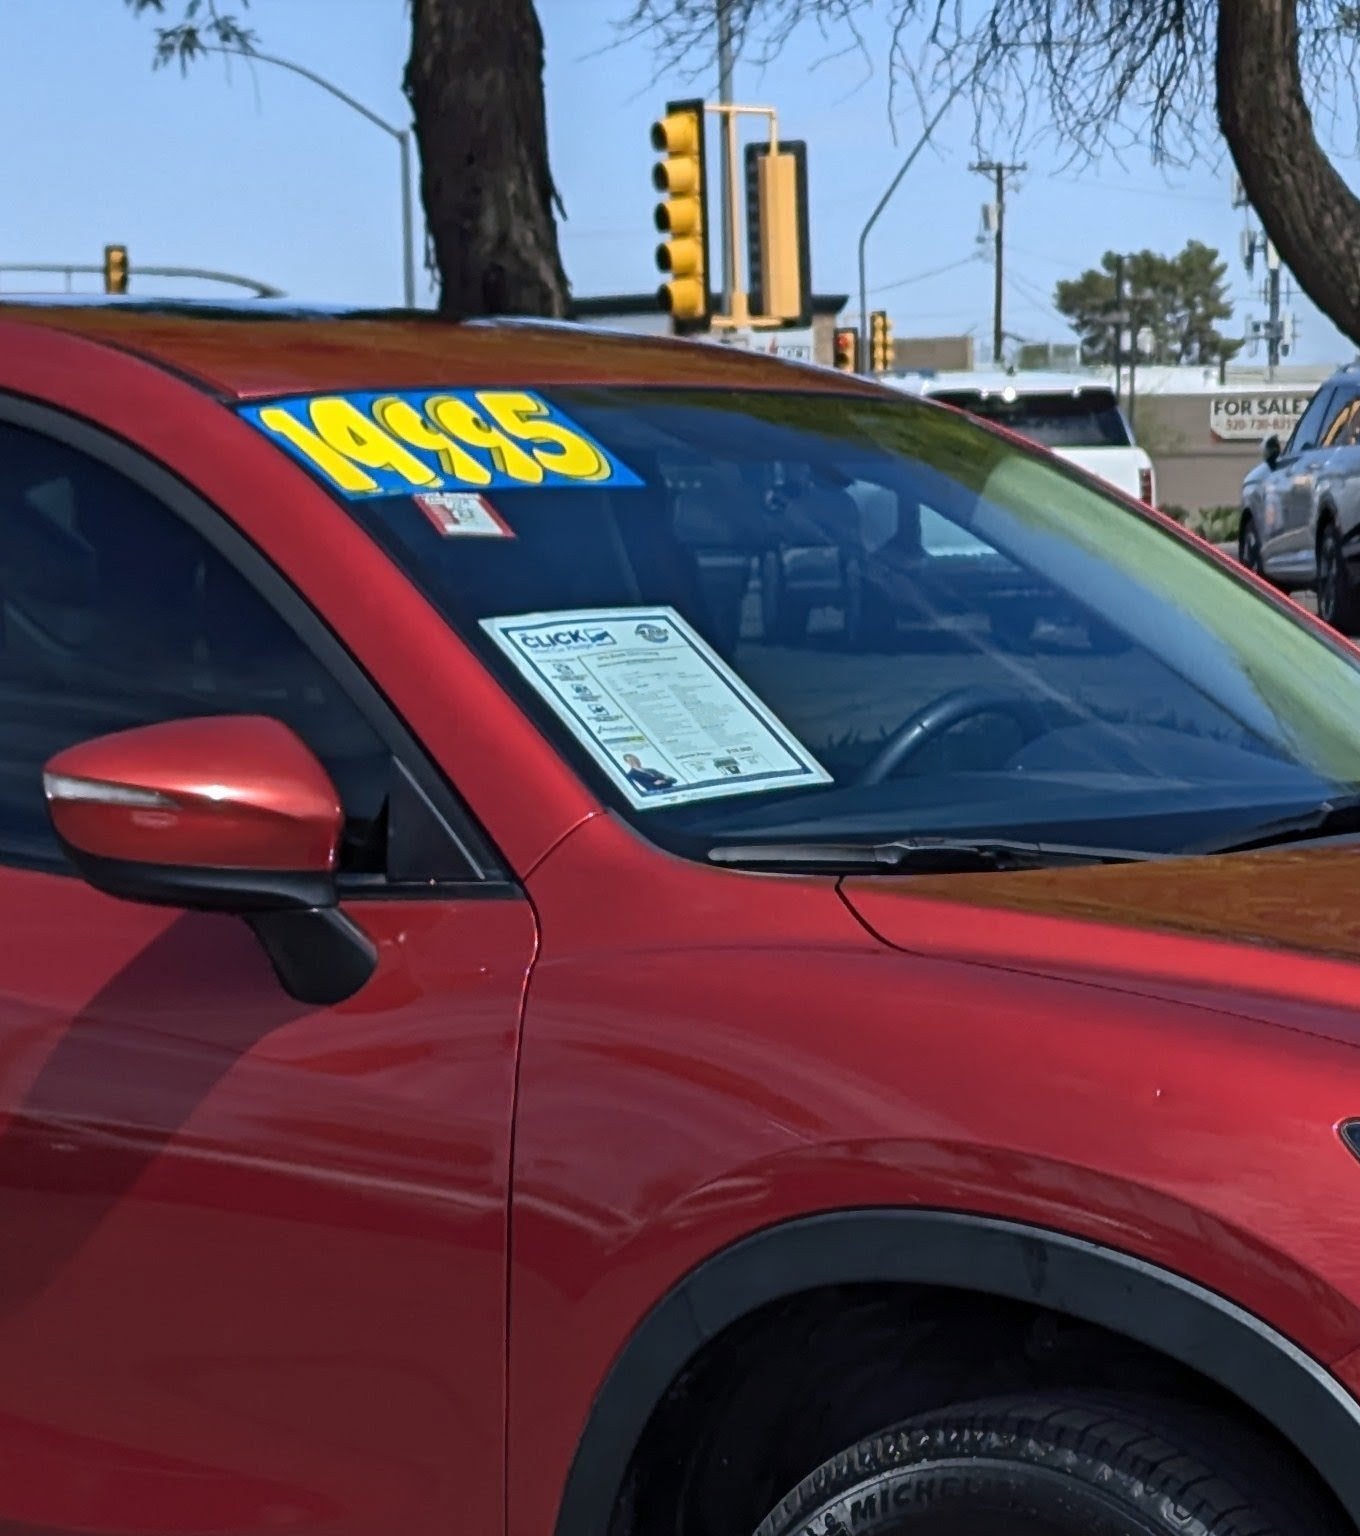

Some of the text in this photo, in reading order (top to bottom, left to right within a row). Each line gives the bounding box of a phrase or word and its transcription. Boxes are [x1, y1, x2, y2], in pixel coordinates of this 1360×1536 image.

[1214, 399, 1302, 416] FOR SALE
[259, 391, 612, 495] 14995
[520, 629, 588, 649] CLICK
[849, 1475, 1014, 1528] MICHELI
